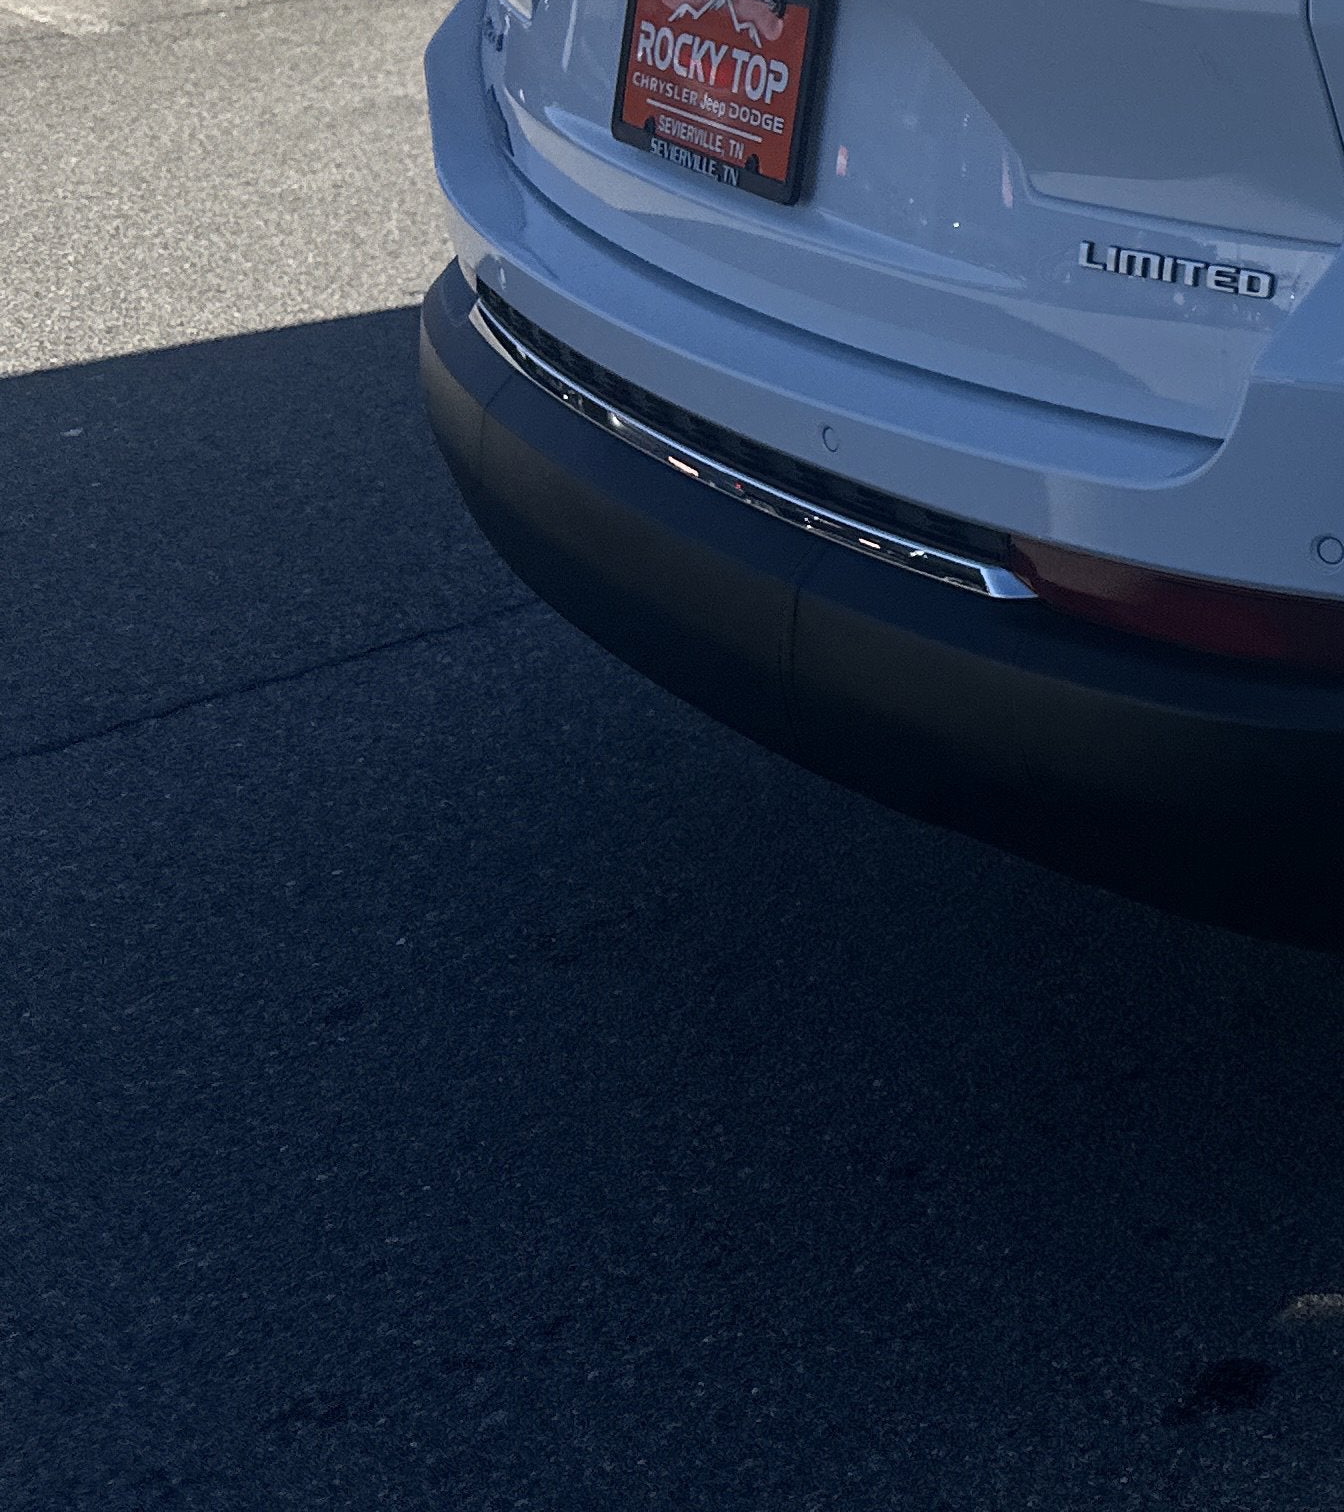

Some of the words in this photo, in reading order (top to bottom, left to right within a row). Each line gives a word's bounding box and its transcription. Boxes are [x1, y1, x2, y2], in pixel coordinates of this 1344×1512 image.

[636, 20, 729, 86] ROCKY
[731, 48, 789, 105] TOP
[632, 71, 699, 106] CHRYSLER
[700, 93, 726, 118] Jeep
[729, 102, 785, 134] DODGE
[723, 164, 739, 187] TN
[729, 139, 745, 160] TN
[1078, 240, 1276, 299] LIMITED
